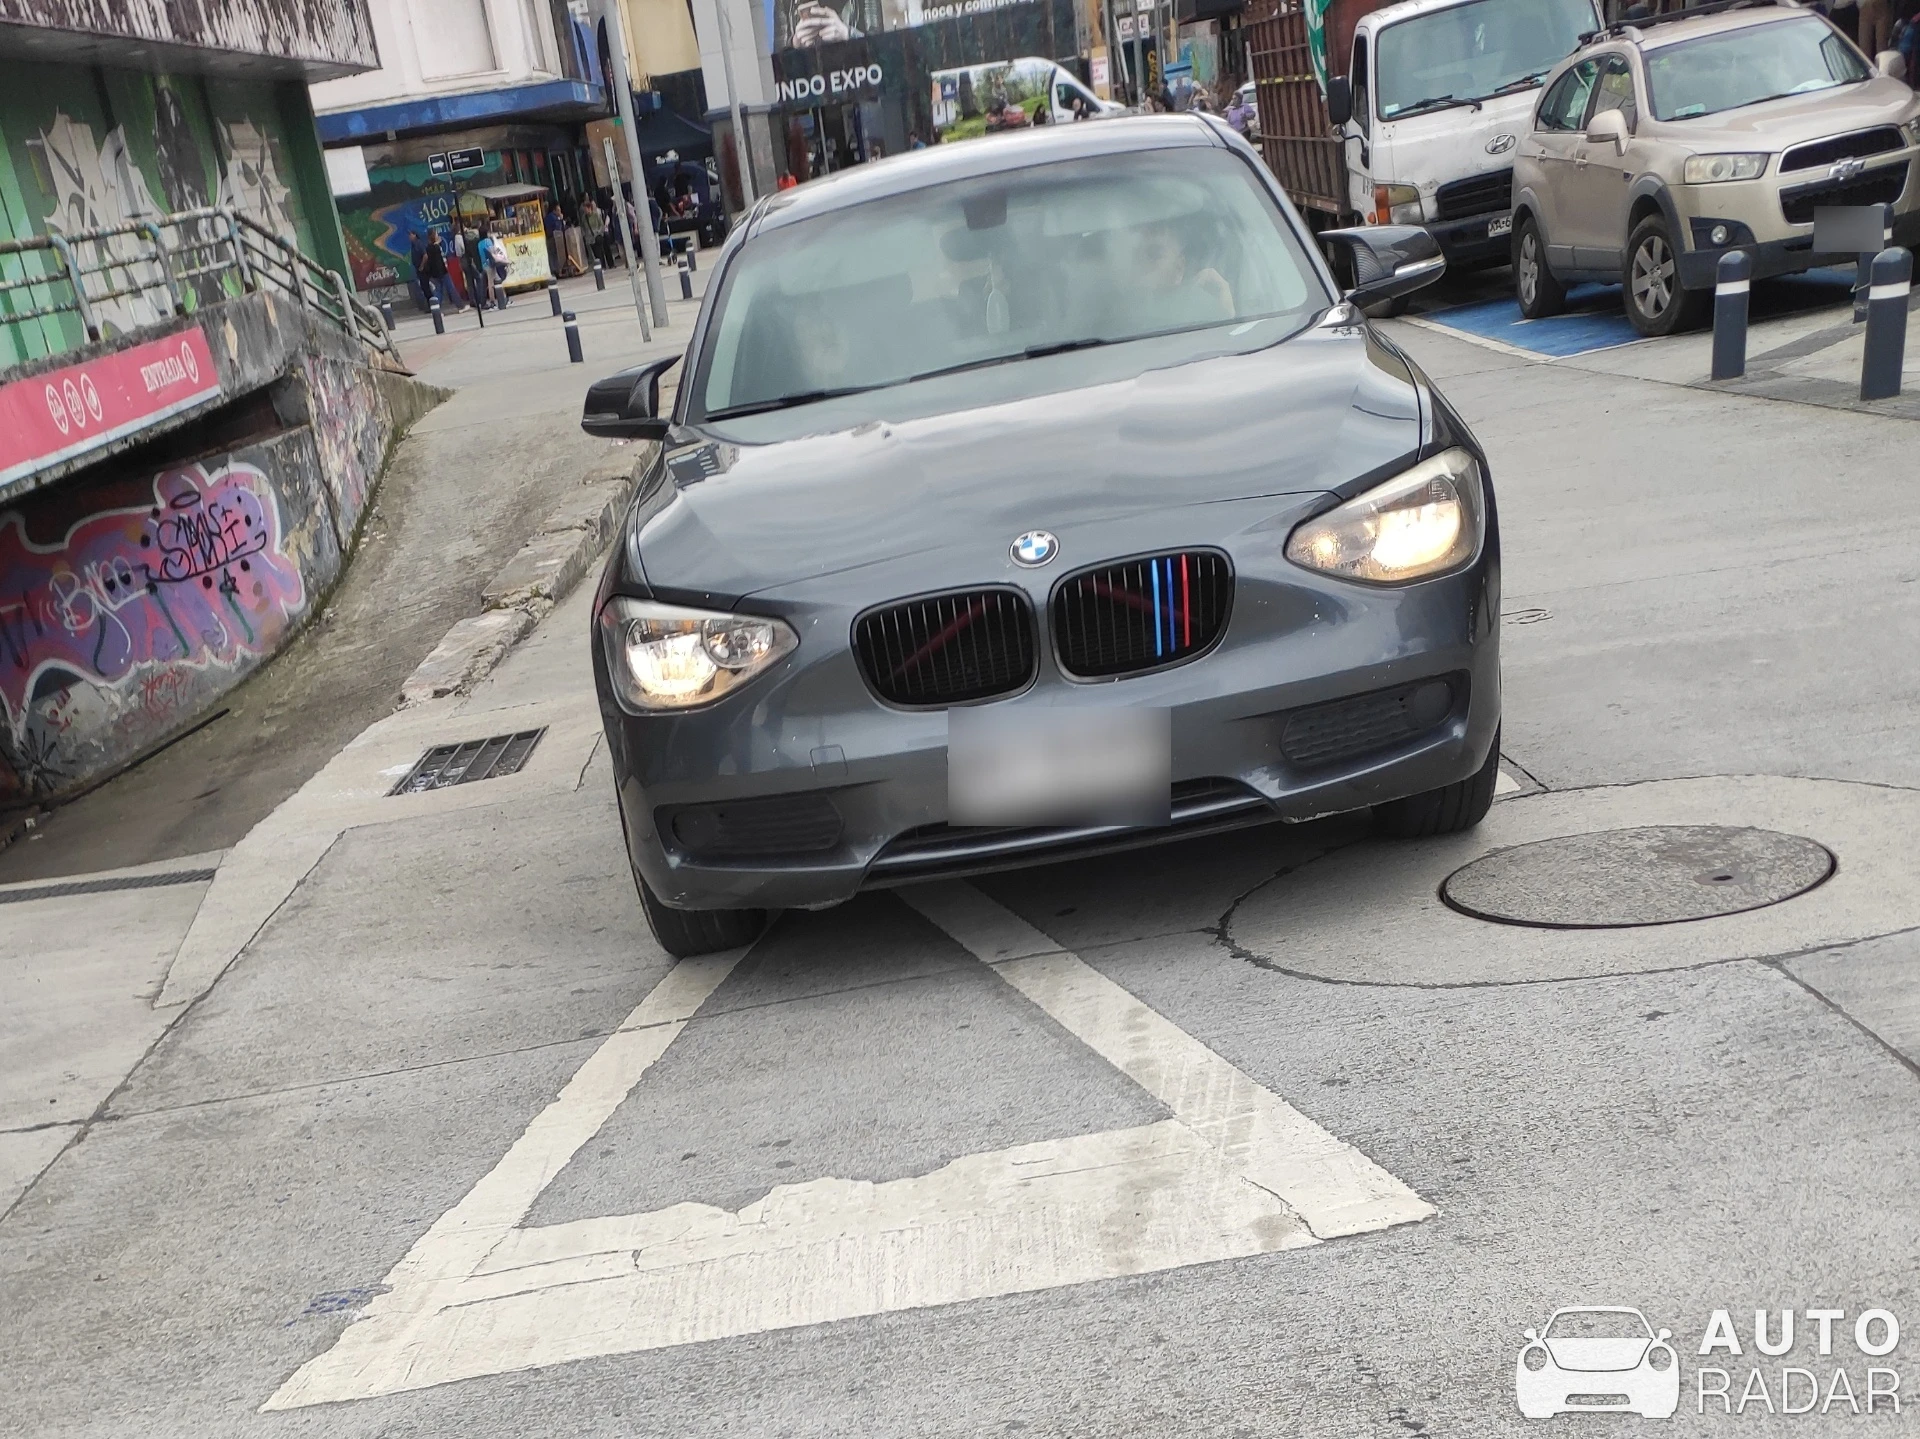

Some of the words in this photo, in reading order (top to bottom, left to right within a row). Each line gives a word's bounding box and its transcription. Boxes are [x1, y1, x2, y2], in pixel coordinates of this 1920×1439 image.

[955, 2, 963, 18] y
[830, 63, 883, 93] EXPO
[422, 197, 448, 223] 160
[139, 354, 187, 393] ENTRADA
